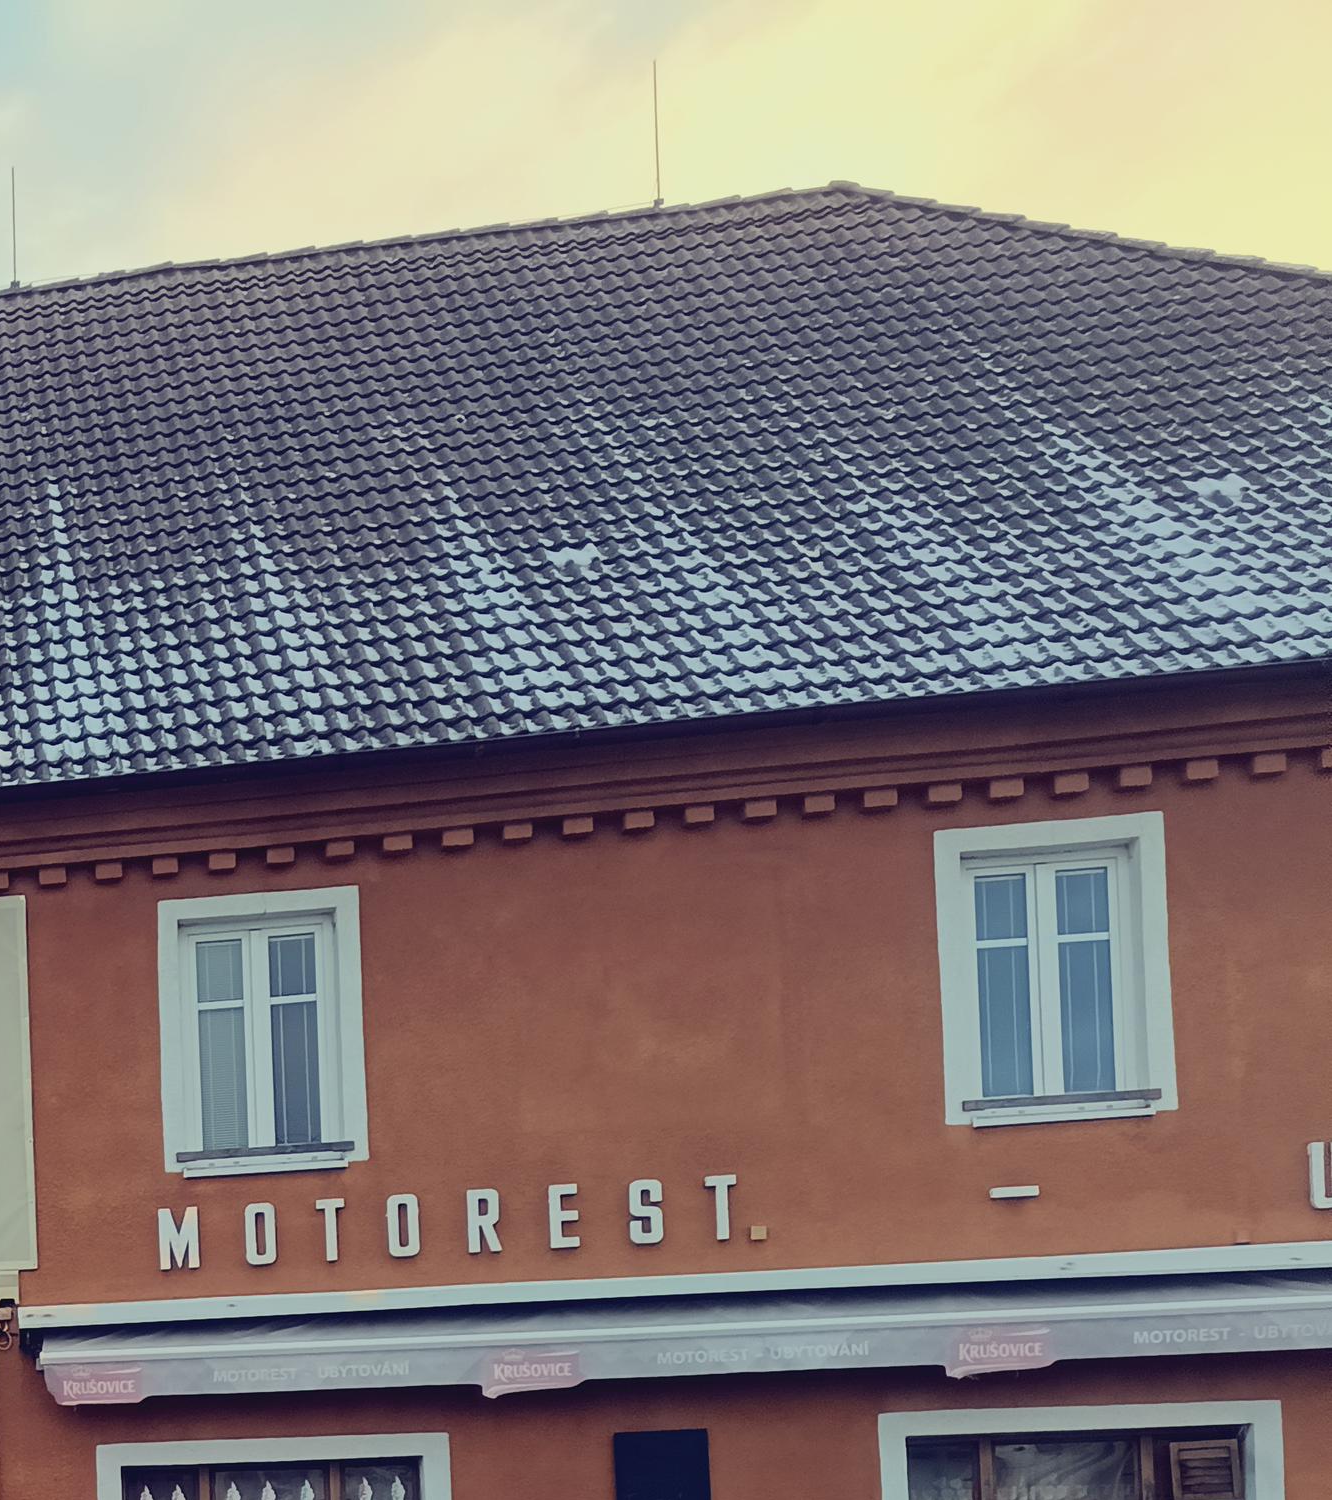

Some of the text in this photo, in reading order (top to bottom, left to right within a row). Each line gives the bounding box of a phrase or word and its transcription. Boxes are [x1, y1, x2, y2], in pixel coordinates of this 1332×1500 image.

[157, 1174, 737, 1271] MOTOREST
[1133, 1327, 1230, 1344] MOTOREST
[657, 1350, 748, 1365] MOTOREST
[770, 1340, 869, 1360] UBYTOVÁNÍ
[959, 1341, 1042, 1363] KRUŠOVICE
[213, 1368, 297, 1383] MOTOREST
[493, 1361, 572, 1382] KRUŠOVICE
[63, 1379, 136, 1399] KRUŠOVICE
